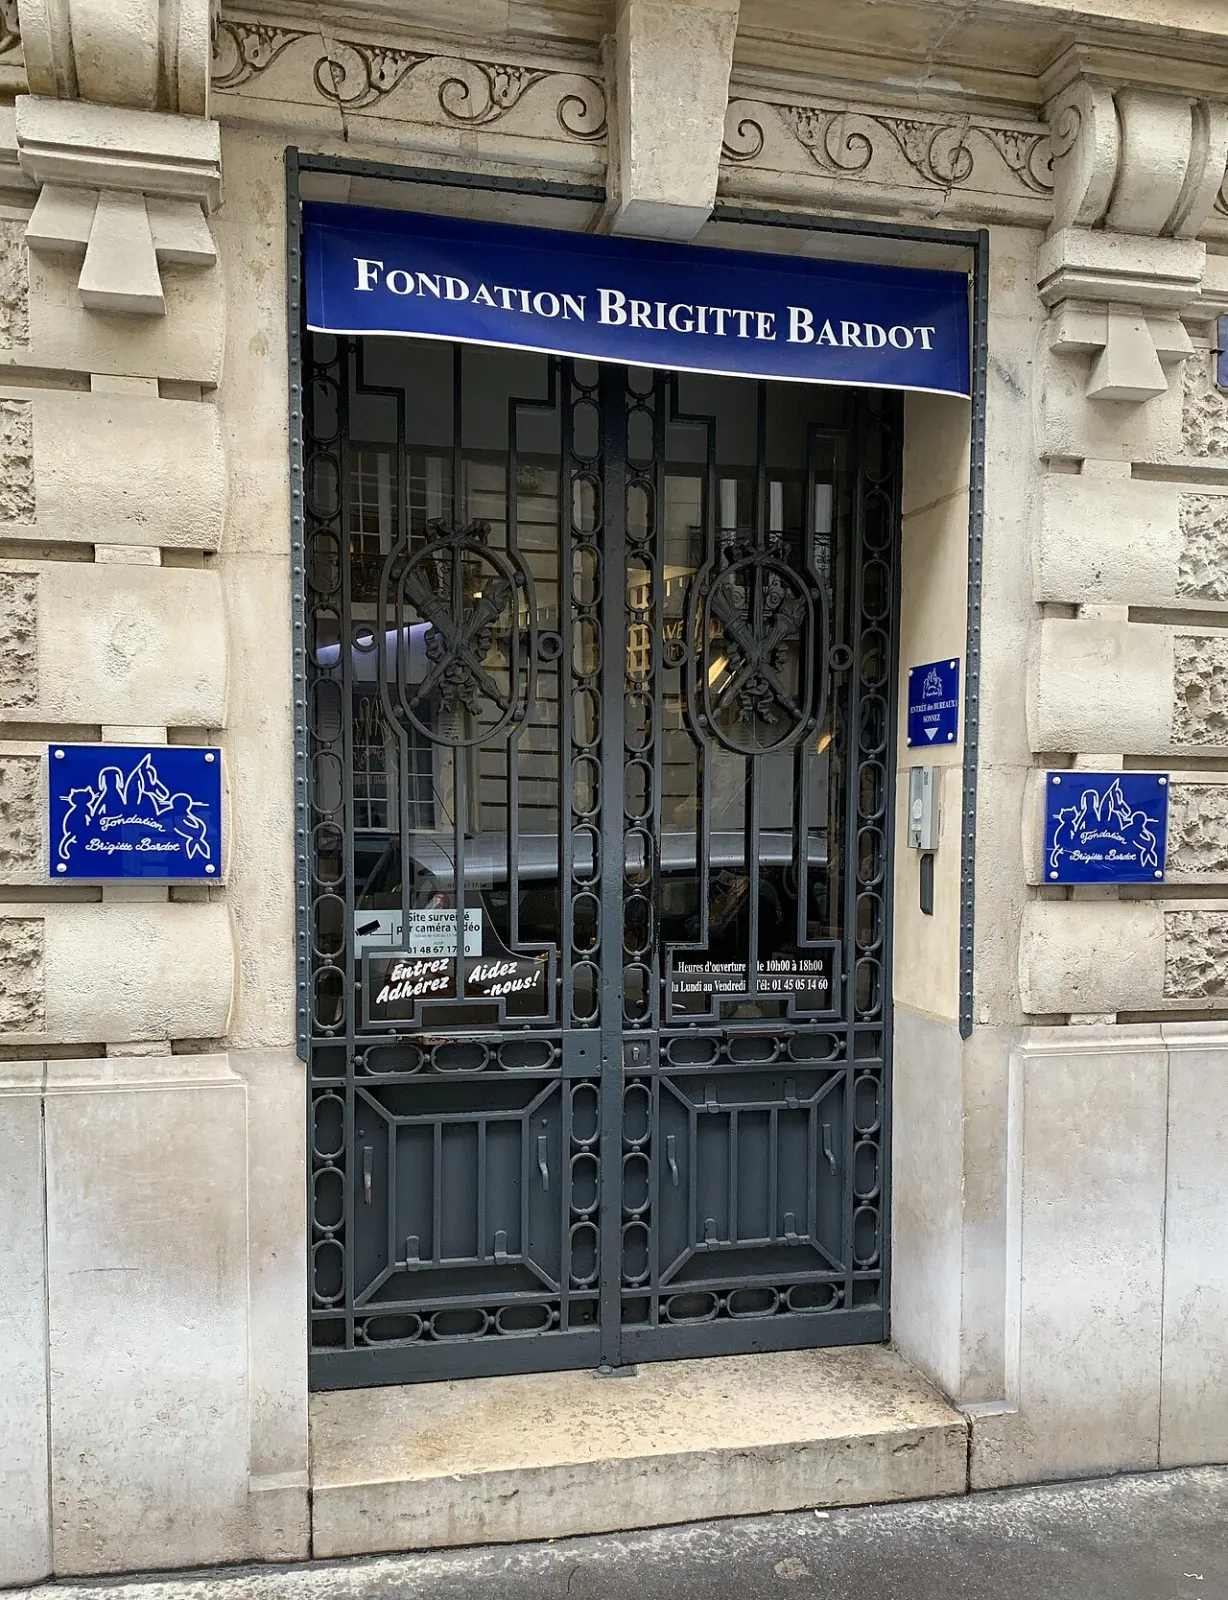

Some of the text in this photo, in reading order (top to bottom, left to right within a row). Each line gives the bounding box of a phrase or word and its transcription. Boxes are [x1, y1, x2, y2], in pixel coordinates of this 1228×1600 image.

[353, 257, 936, 350] FONDATION BRIGITTE BARDOT
[100, 814, 166, 832] Fondation
[1080, 829, 1127, 844] Fondation
[85, 837, 181, 855] Brigitte Bardot
[1069, 849, 1137, 864] Brigitte Bardot
[409, 911, 426, 922] Site
[396, 924, 414, 935] pr
[415, 922, 451, 933] caméra
[453, 922, 480, 932] vdéo
[408, 946, 417, 954] 01
[433, 945, 444, 953] 67
[447, 945, 457, 953] 17
[391, 958, 450, 982] Entrez
[468, 959, 518, 984] Aidez
[678, 961, 704, 973] Heures
[704, 961, 747, 973] d'ouverture
[766, 960, 790, 972] 10h00
[791, 960, 797, 971] à
[799, 960, 823, 971] 18h00
[376, 976, 450, 1004] Adhérez
[483, 970, 541, 997] -nous!
[680, 980, 702, 992] Lundi
[703, 981, 713, 991] au
[714, 979, 746, 991] Vendredi
[771, 979, 782, 991] 01
[784, 979, 794, 991] 45
[795, 979, 805, 990] 05
[807, 979, 817, 990] 14
[818, 978, 828, 990] 60
